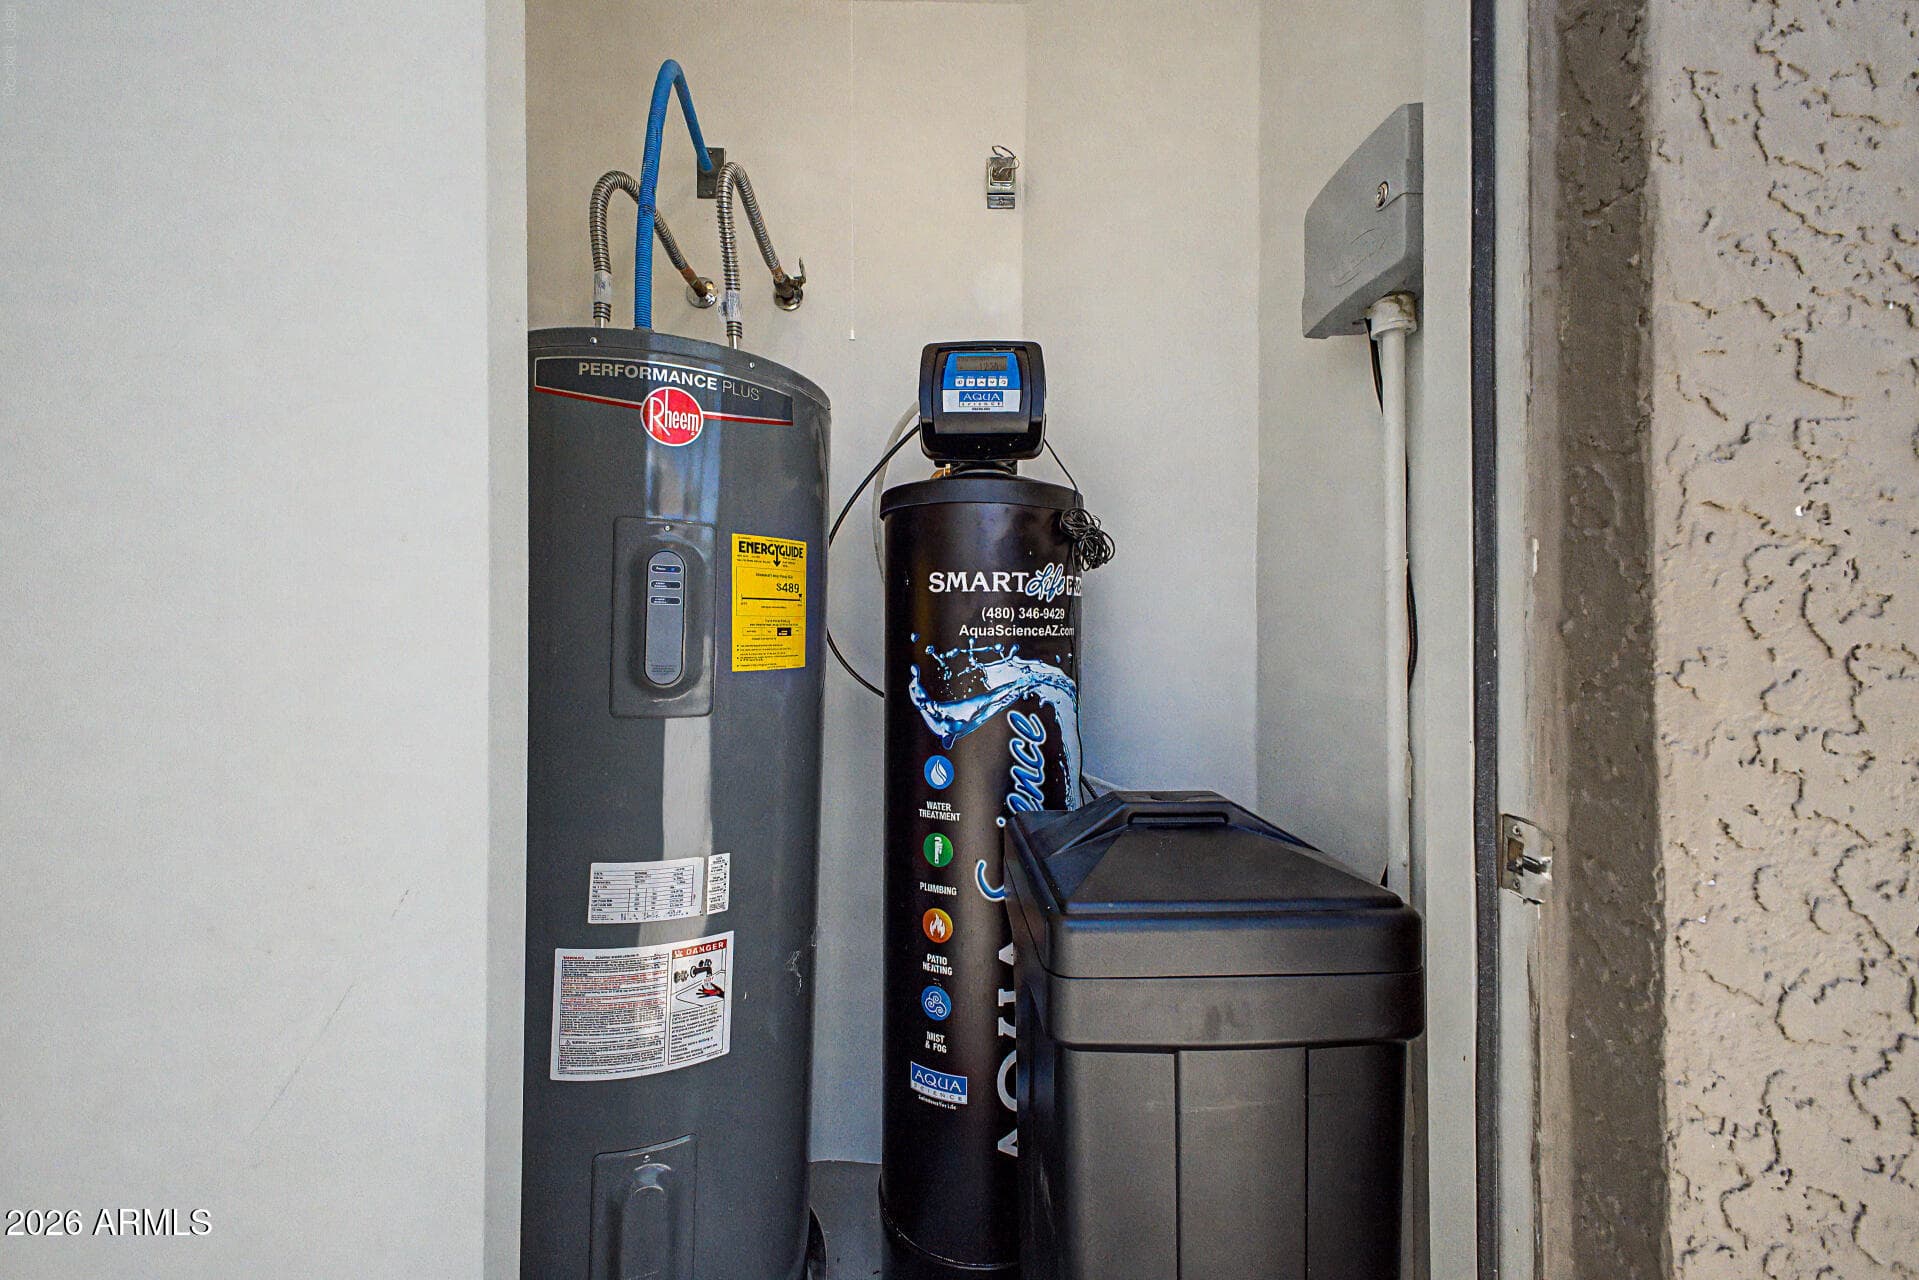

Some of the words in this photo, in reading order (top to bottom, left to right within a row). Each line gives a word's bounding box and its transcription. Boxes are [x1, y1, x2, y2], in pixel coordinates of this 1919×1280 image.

[578, 361, 718, 391] PERFORMANCE
[722, 379, 761, 402] PLUS
[963, 393, 1001, 401] AQUA
[648, 388, 700, 437] Rheem
[738, 540, 804, 559] ENERGYGUIDE
[928, 571, 1029, 593] SMART
[1025, 562, 1066, 602] Life
[981, 607, 1015, 622] (480)
[1018, 607, 1066, 621] 346-9429
[959, 624, 1075, 638] AquaScienceAZ.com
[926, 800, 952, 812] WATER
[918, 808, 961, 822] TREATMENT
[919, 881, 958, 896] PLUMBING
[686, 941, 725, 956] DANGER
[926, 953, 948, 965] PATIO
[922, 961, 953, 976] HEATING
[926, 1031, 945, 1044] MIST
[932, 1043, 947, 1054] FOG
[914, 1070, 963, 1093] AQUA
